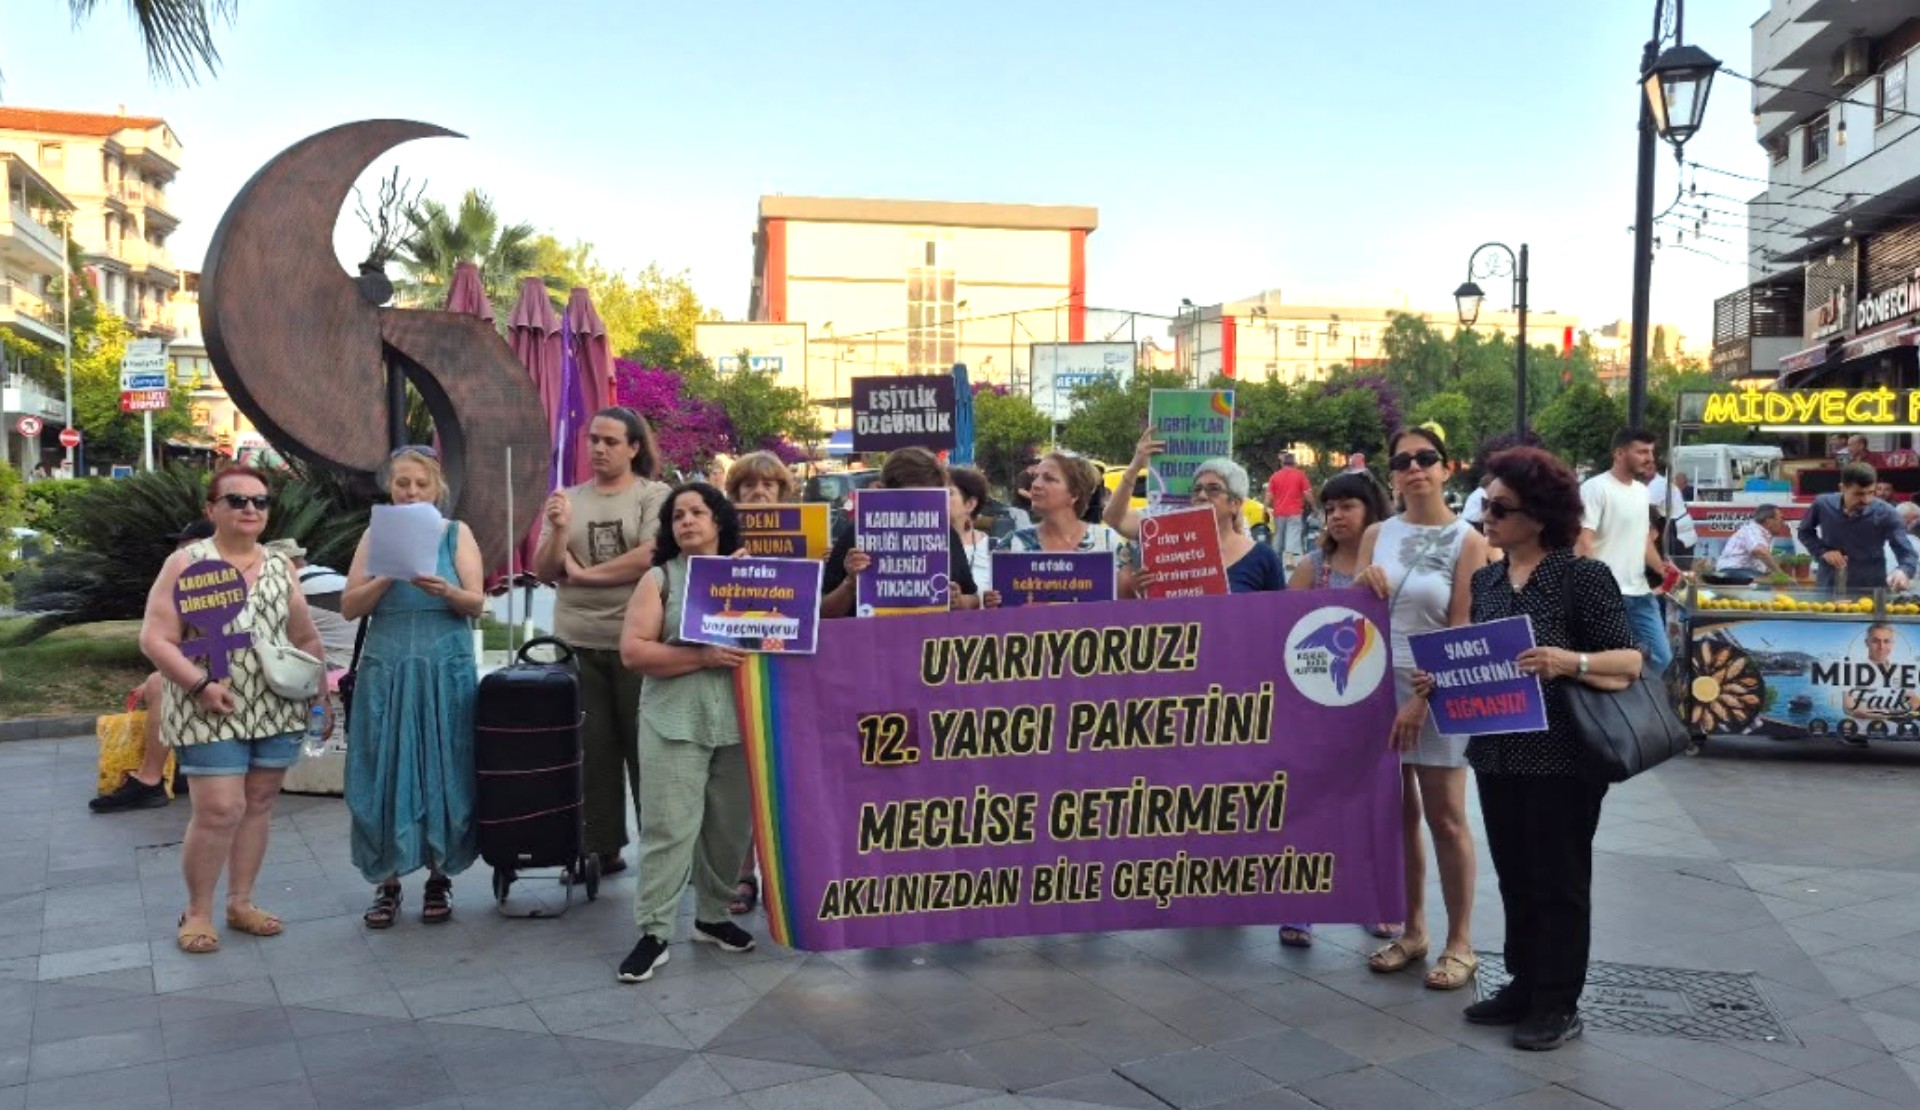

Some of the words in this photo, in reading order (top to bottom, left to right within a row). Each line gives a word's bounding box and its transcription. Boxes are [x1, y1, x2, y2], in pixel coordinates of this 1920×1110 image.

[868, 384, 937, 412] EŞİTLİK
[1704, 385, 1896, 423] MİDYECİ
[856, 408, 951, 436] ÖZGÜRLÜK
[744, 536, 794, 554] ANUNA
[876, 580, 931, 597] YIKACAK
[921, 622, 1201, 686] UYARIYORUZ!
[1444, 637, 1490, 660] YARGI
[1849, 688, 1911, 712] Faik
[858, 713, 920, 764] 12.
[929, 703, 1055, 760] YARGI
[1066, 682, 1274, 752] PAKETİNİ
[858, 785, 1038, 854] MECLİSE
[1048, 771, 1287, 841] GETİRMEYİ
[817, 866, 1023, 920] AKLINIZDAN
[1030, 856, 1104, 904] BİLE
[1111, 846, 1335, 908] GEÇİRMEYİN!
